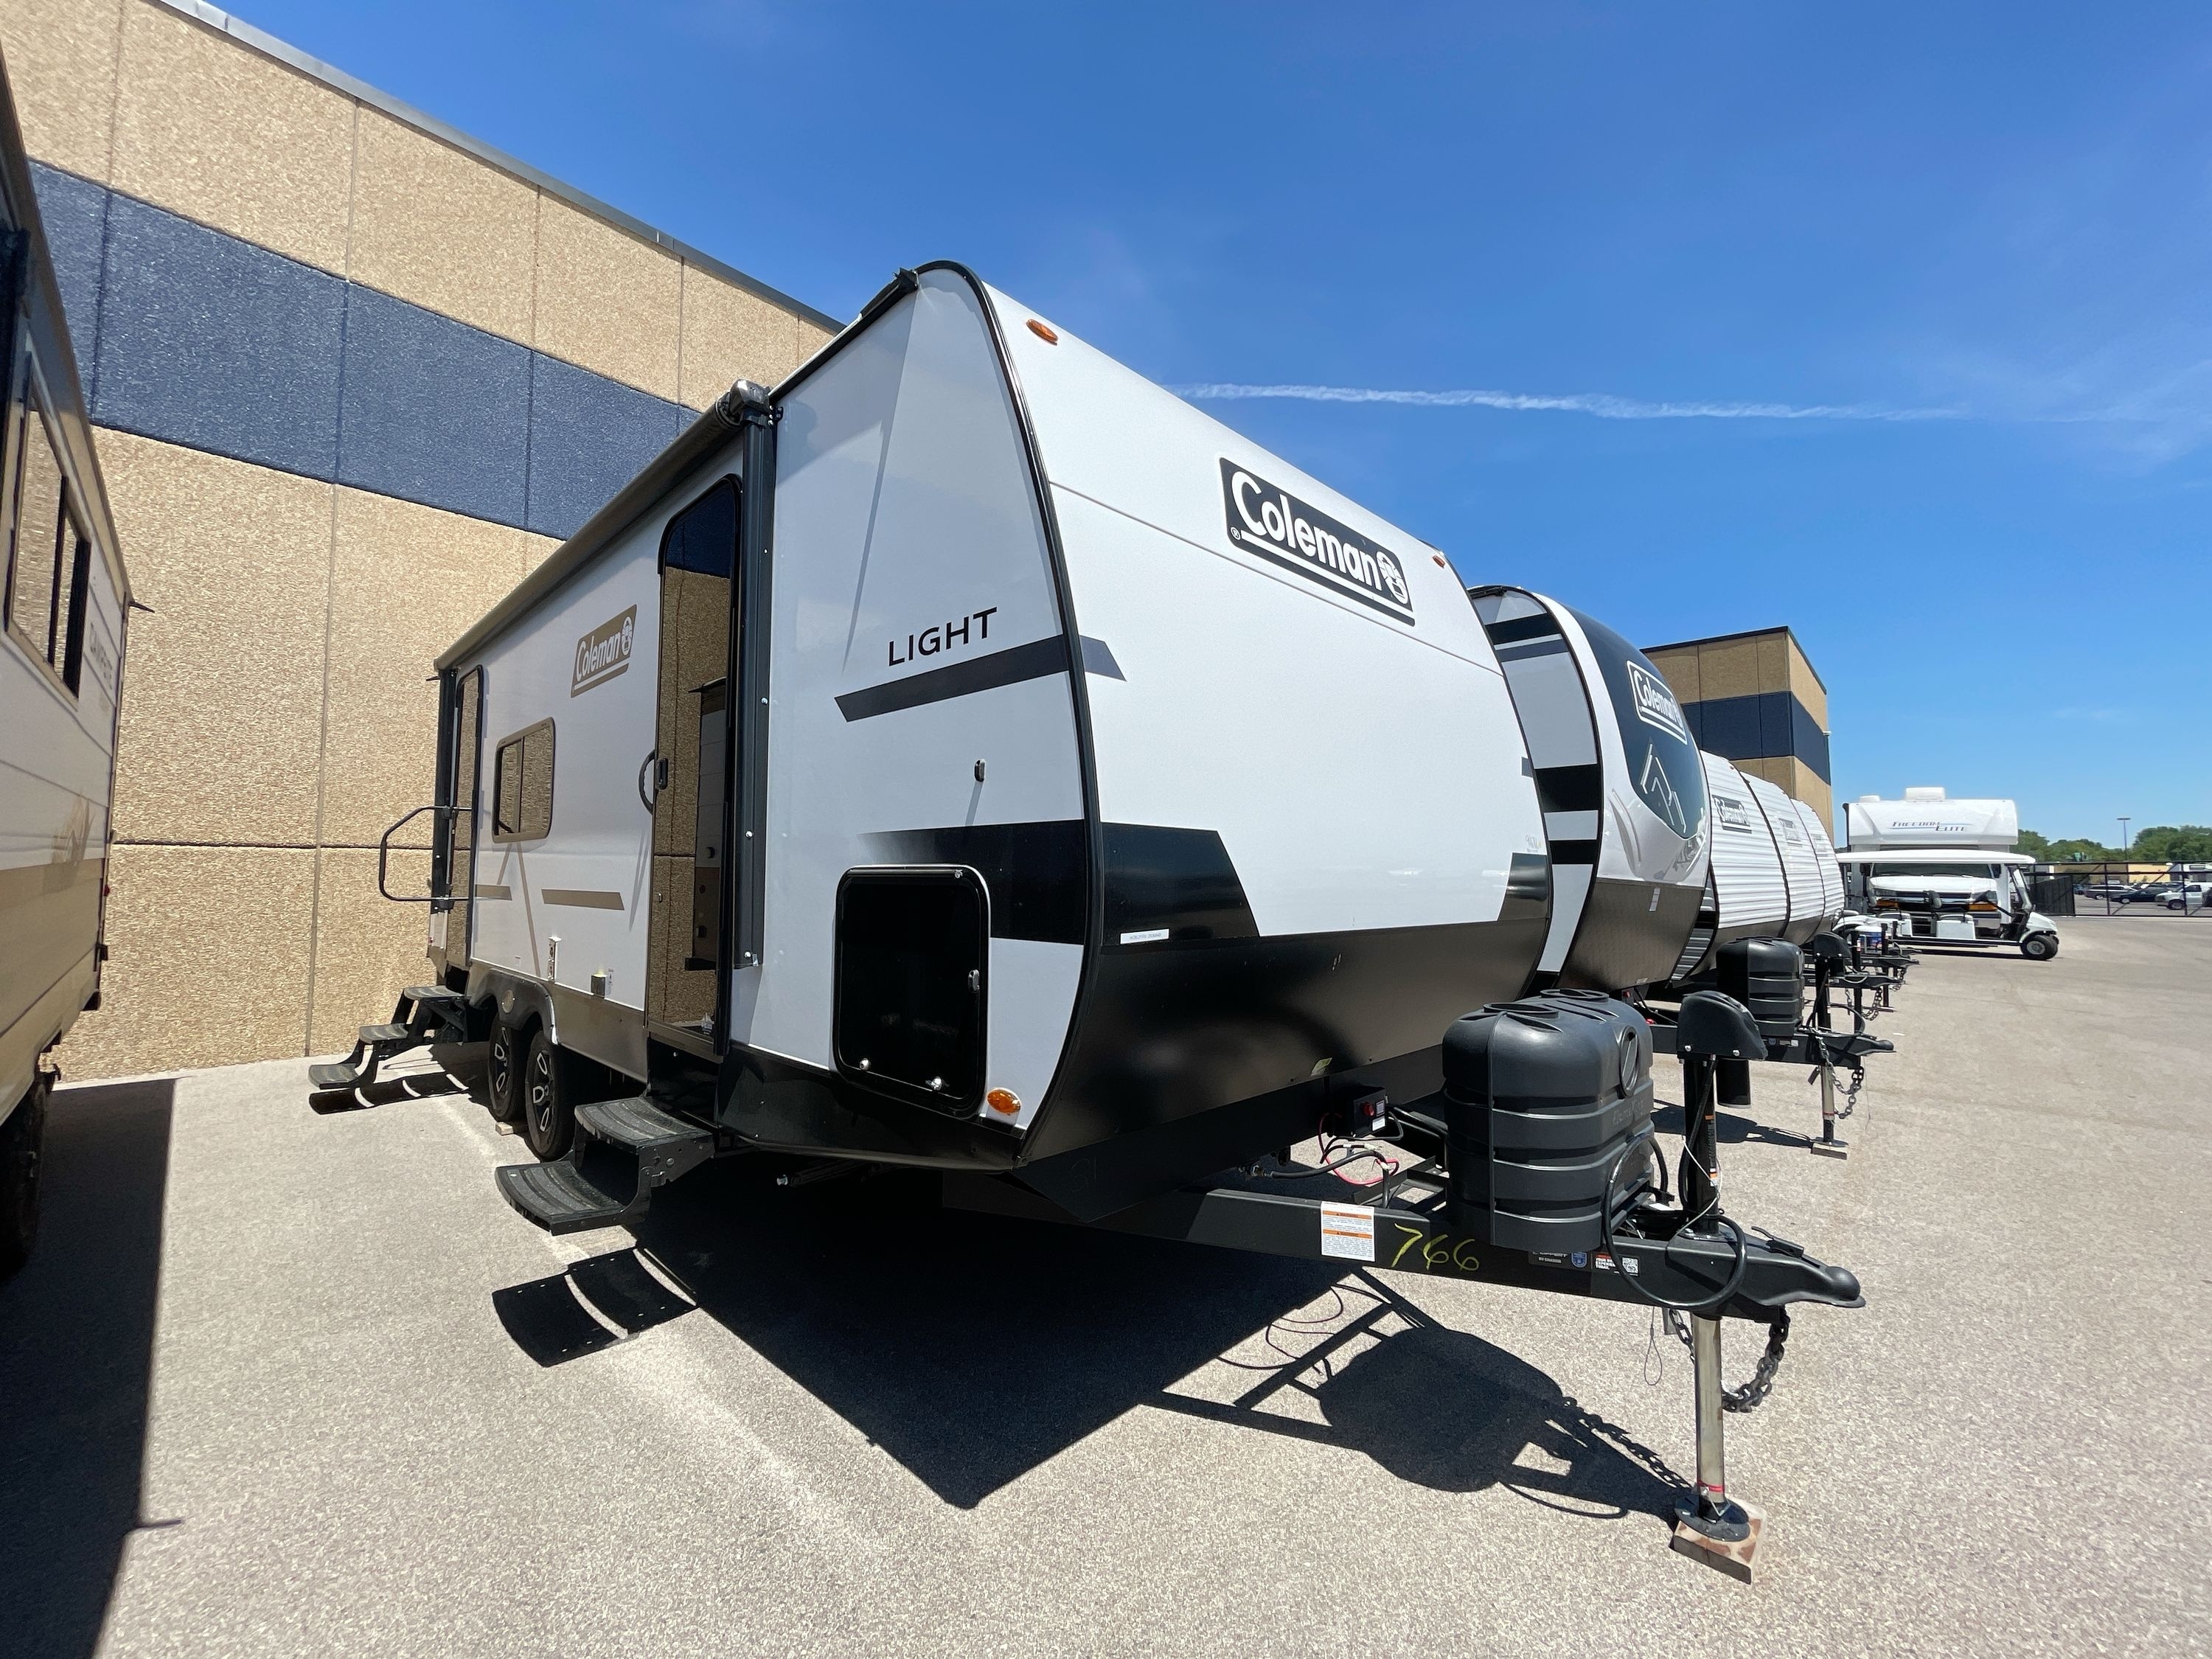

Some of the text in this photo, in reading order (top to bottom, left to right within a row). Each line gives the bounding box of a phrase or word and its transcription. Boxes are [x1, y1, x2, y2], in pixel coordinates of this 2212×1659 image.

[1231, 471, 1382, 591] Coleman
[576, 631, 621, 681] Coleman
[889, 607, 997, 667] LIGHT
[1634, 670, 1677, 723] Coleman
[1391, 1222, 1479, 1270] 766
